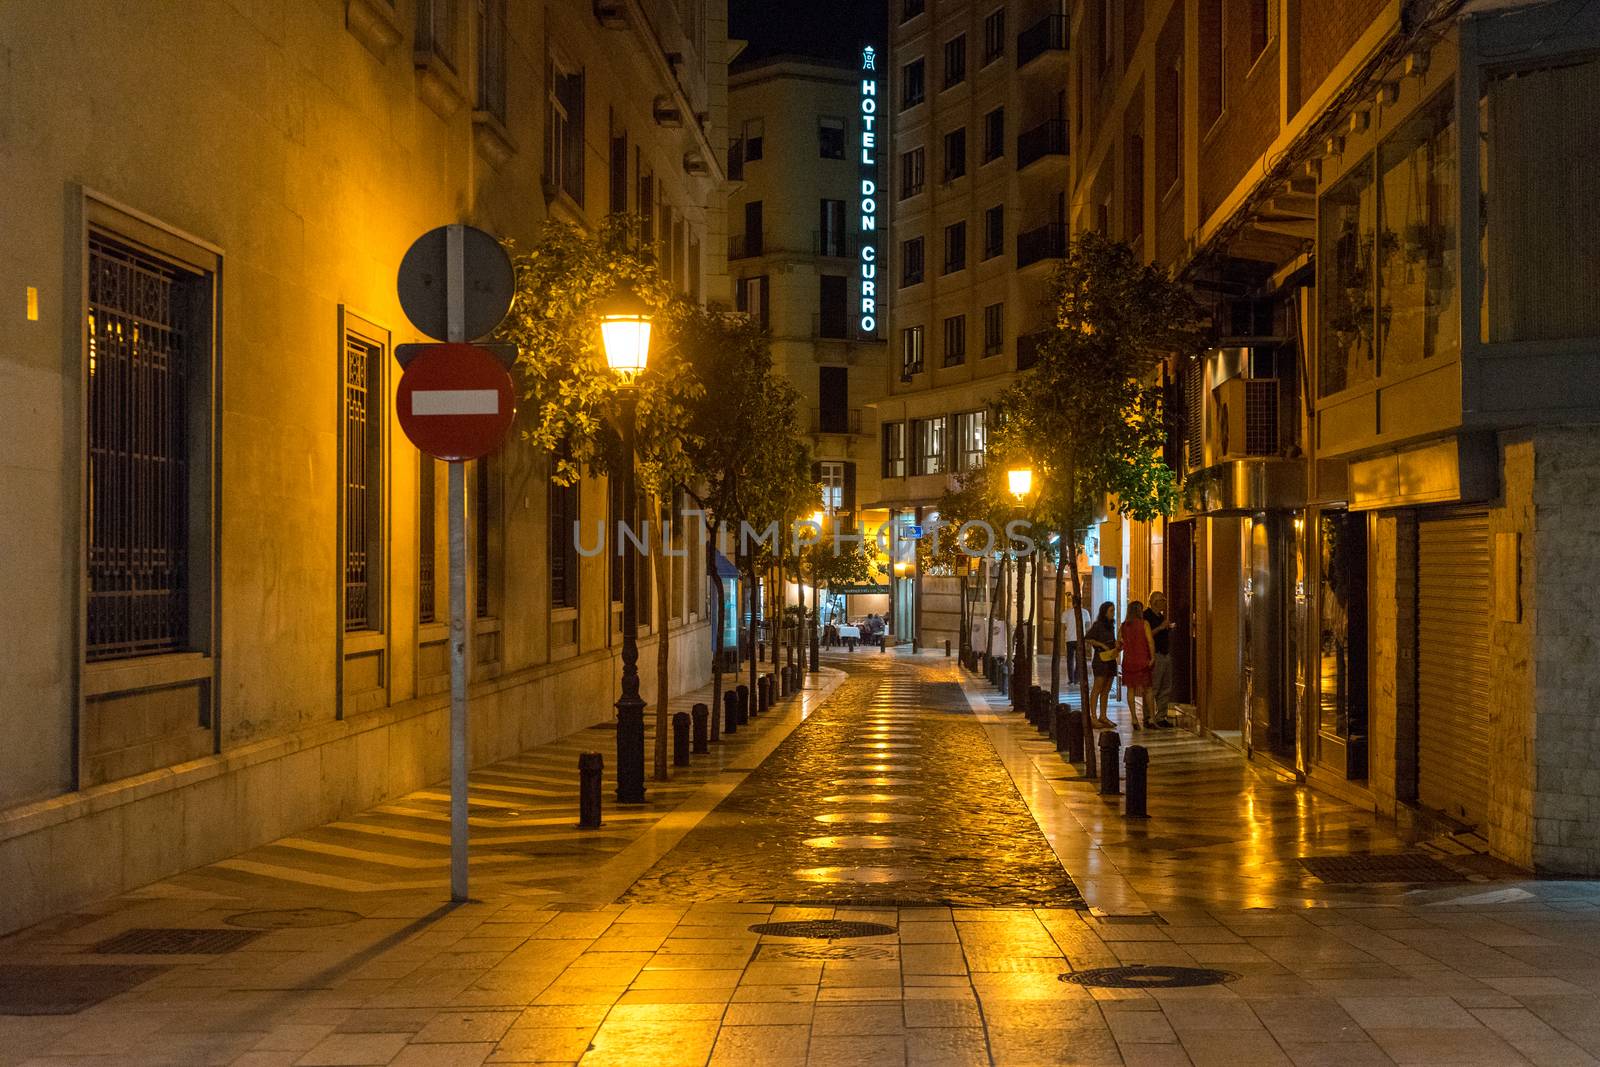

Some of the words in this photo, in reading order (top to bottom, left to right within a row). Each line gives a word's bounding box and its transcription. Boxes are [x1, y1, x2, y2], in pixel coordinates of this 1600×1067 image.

[862, 80, 876, 165] HOTEL
[861, 180, 876, 231] DON
[861, 246, 876, 332] CURRO
